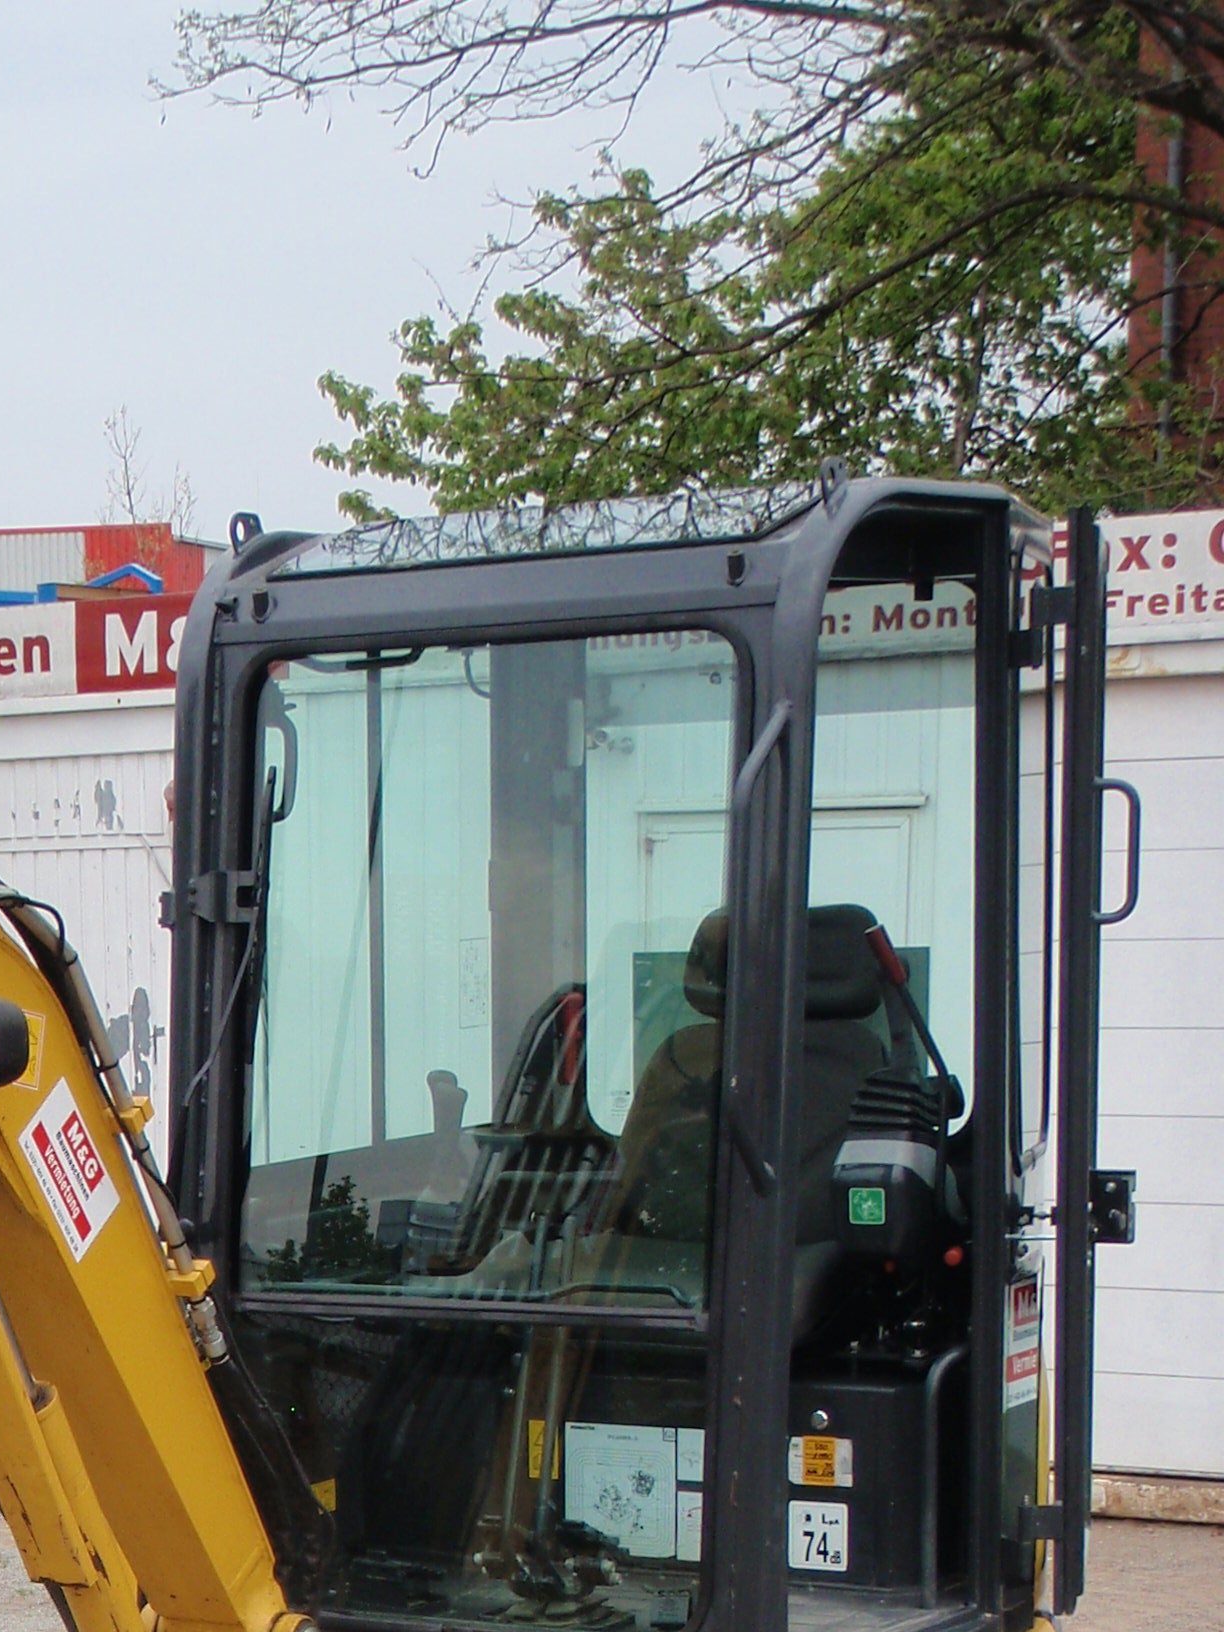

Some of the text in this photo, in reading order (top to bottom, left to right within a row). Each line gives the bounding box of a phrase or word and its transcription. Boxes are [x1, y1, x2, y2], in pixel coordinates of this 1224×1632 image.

[43, 1143, 81, 1220] Vermietung
[55, 1130, 91, 1202] Baumaschinen
[67, 1120, 99, 1180] M&G
[802, 1530, 829, 1563] 74
